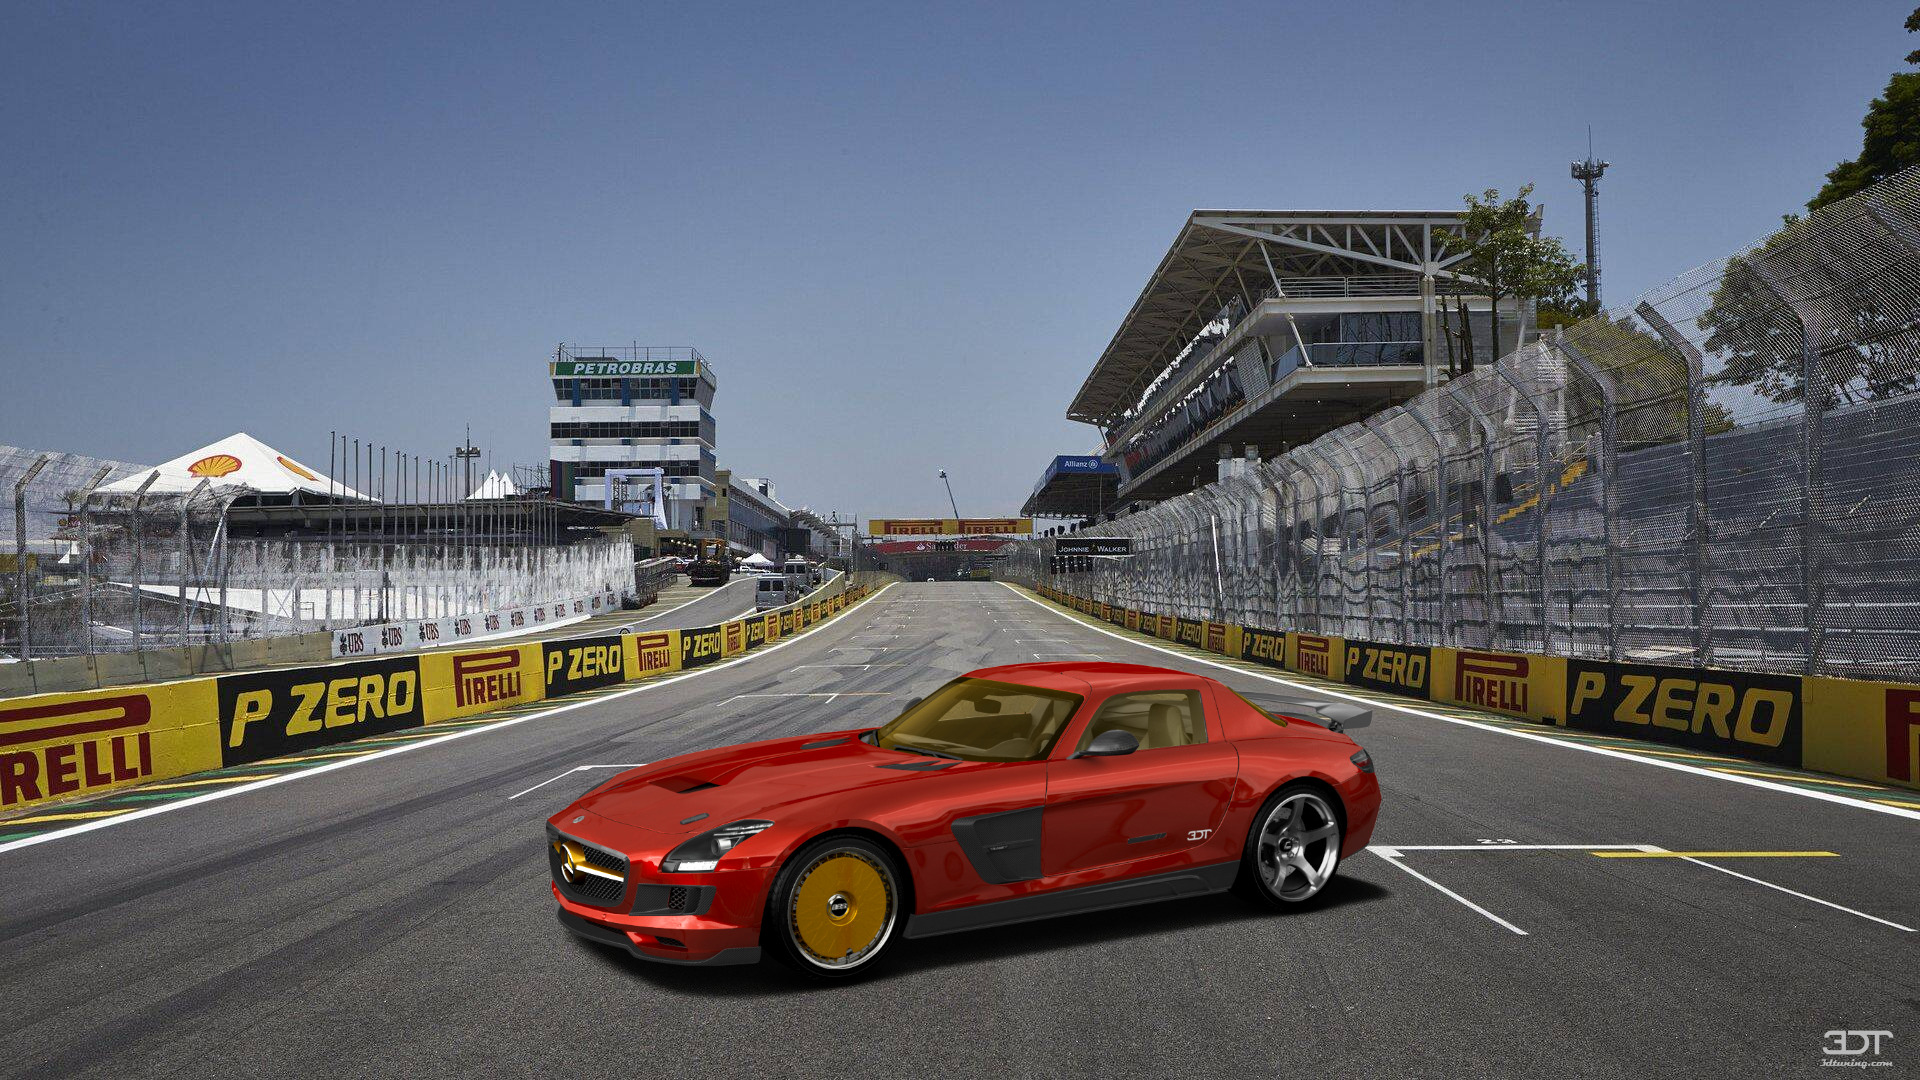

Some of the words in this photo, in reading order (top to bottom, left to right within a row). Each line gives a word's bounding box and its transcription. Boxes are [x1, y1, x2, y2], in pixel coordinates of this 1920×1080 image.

[573, 362, 677, 374] PETROBRAS
[1064, 460, 1088, 468] Allianz
[884, 521, 943, 534] PIRELLI
[958, 520, 1018, 534] PIRELLI
[926, 541, 967, 550] Sader
[1058, 545, 1089, 553] JOHNNIE
[1097, 545, 1127, 553] WALKER
[388, 626, 403, 647] UBS
[425, 622, 440, 641] UBS
[459, 618, 472, 636] UBS
[1182, 622, 1201, 643] ZERO
[347, 632, 364, 654] UBS
[637, 633, 671, 672] PIRELLI
[683, 638, 692, 661] P
[692, 632, 721, 658] ZERO
[1243, 634, 1250, 653] P
[1251, 635, 1284, 662] ZERO
[547, 650, 564, 684] P
[567, 645, 621, 680] ZERO
[1297, 634, 1329, 676] PIRELLI
[453, 649, 521, 708] PIRELLI
[1346, 647, 1359, 675] P
[1361, 650, 1427, 689] ZERO
[1455, 651, 1529, 714] PIRELLI
[229, 689, 273, 749] P
[285, 670, 417, 737] ZERO
[1570, 671, 1606, 715] P
[1613, 674, 1794, 747] ZERO
[1187, 829, 1212, 841] 3DT
